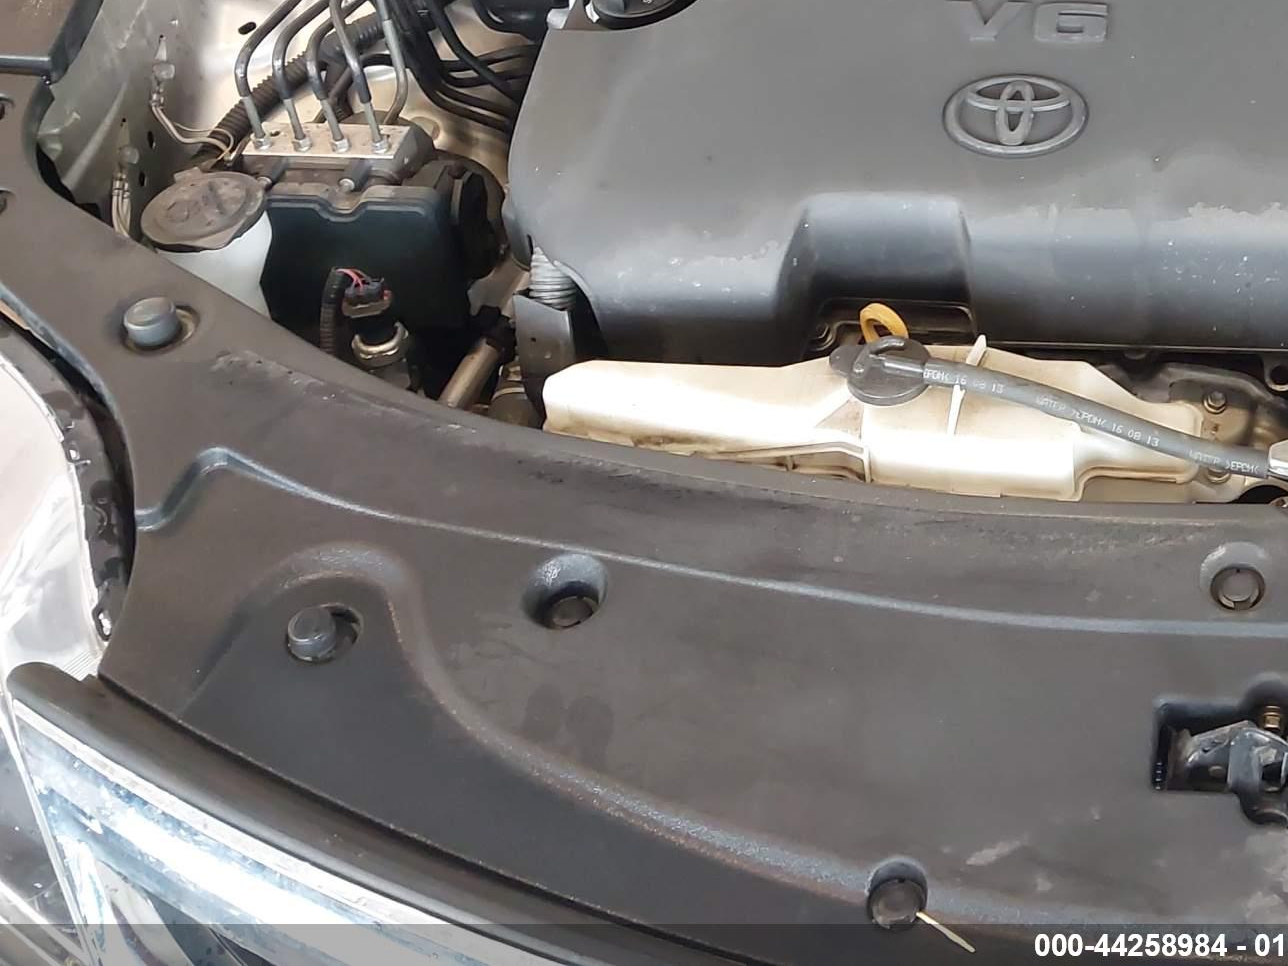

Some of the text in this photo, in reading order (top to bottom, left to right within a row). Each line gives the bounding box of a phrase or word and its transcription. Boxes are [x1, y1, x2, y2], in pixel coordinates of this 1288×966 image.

[1112, 423, 1122, 434] 16
[1128, 430, 1141, 441] 08
[1147, 436, 1160, 447] 13
